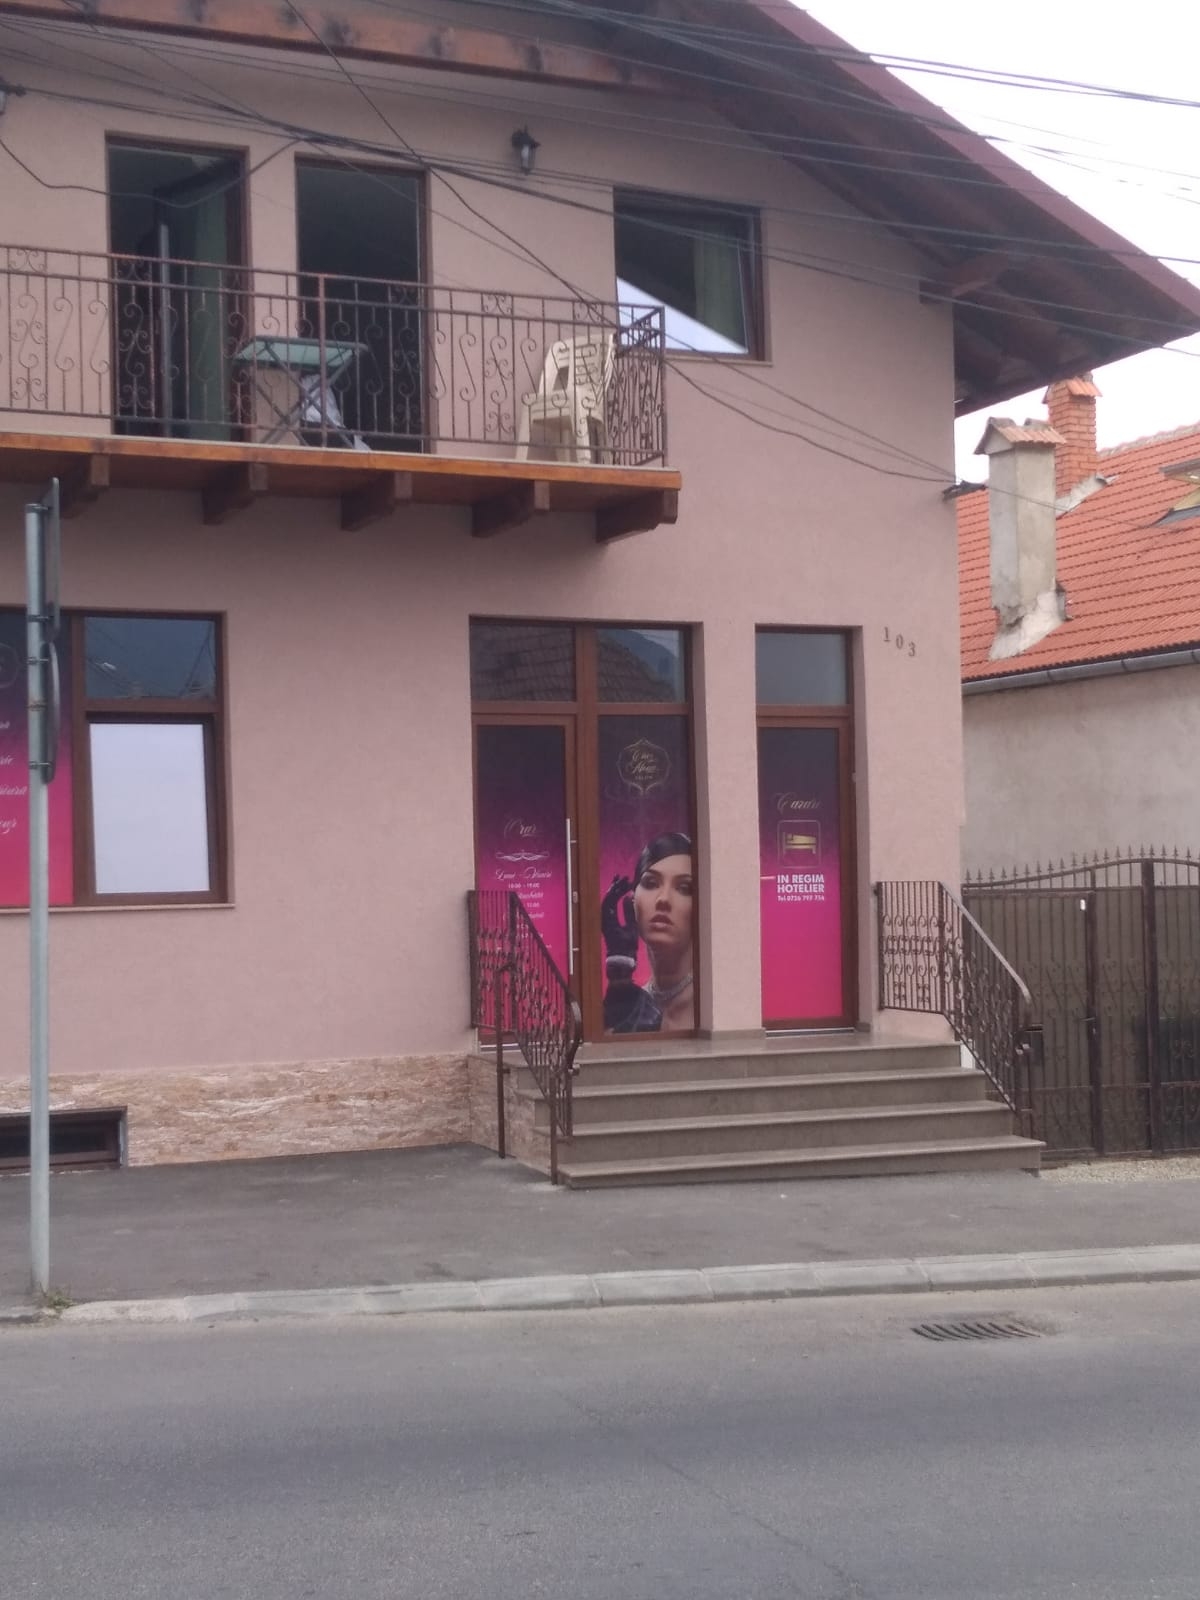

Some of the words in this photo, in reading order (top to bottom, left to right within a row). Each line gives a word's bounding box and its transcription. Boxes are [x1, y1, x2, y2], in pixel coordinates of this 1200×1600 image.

[883, 626, 916, 657] 103
[777, 874, 789, 884] IN
[792, 874, 825, 883] REGIM
[777, 884, 825, 893] HOTELIER
